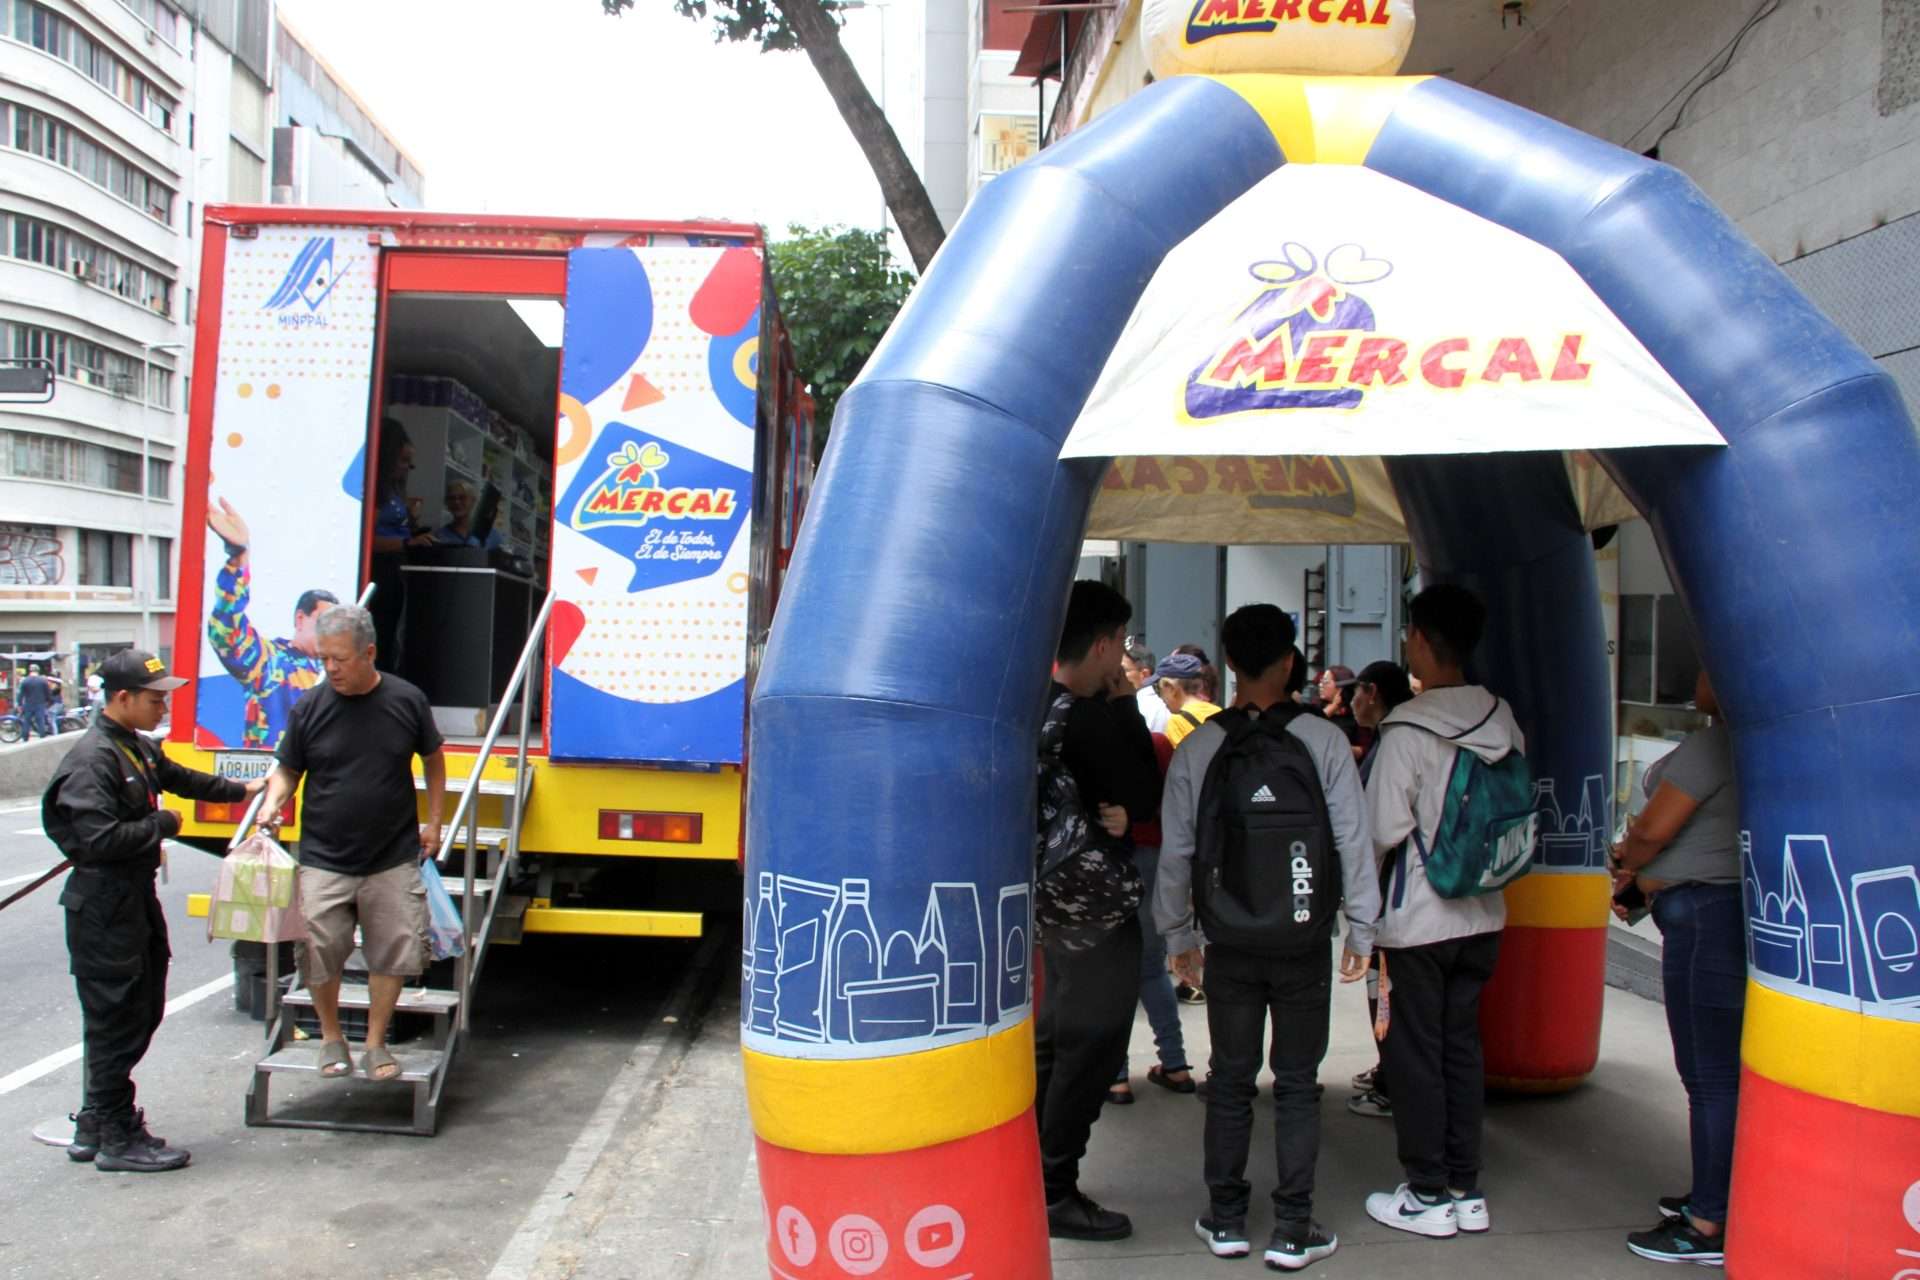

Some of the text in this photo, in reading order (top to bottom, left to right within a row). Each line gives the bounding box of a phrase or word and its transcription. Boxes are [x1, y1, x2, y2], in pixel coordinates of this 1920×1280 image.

[1199, 0, 1391, 25] MERCAL
[278, 313, 329, 327] MINPPAL
[1209, 334, 1591, 388] MERCAL
[589, 488, 733, 515] MERCAL
[644, 528, 716, 547] El de Todos,
[635, 544, 652, 560] El
[652, 546, 669, 560] de
[218, 761, 273, 778] A08AU9
[1289, 840, 1313, 923] adidas
